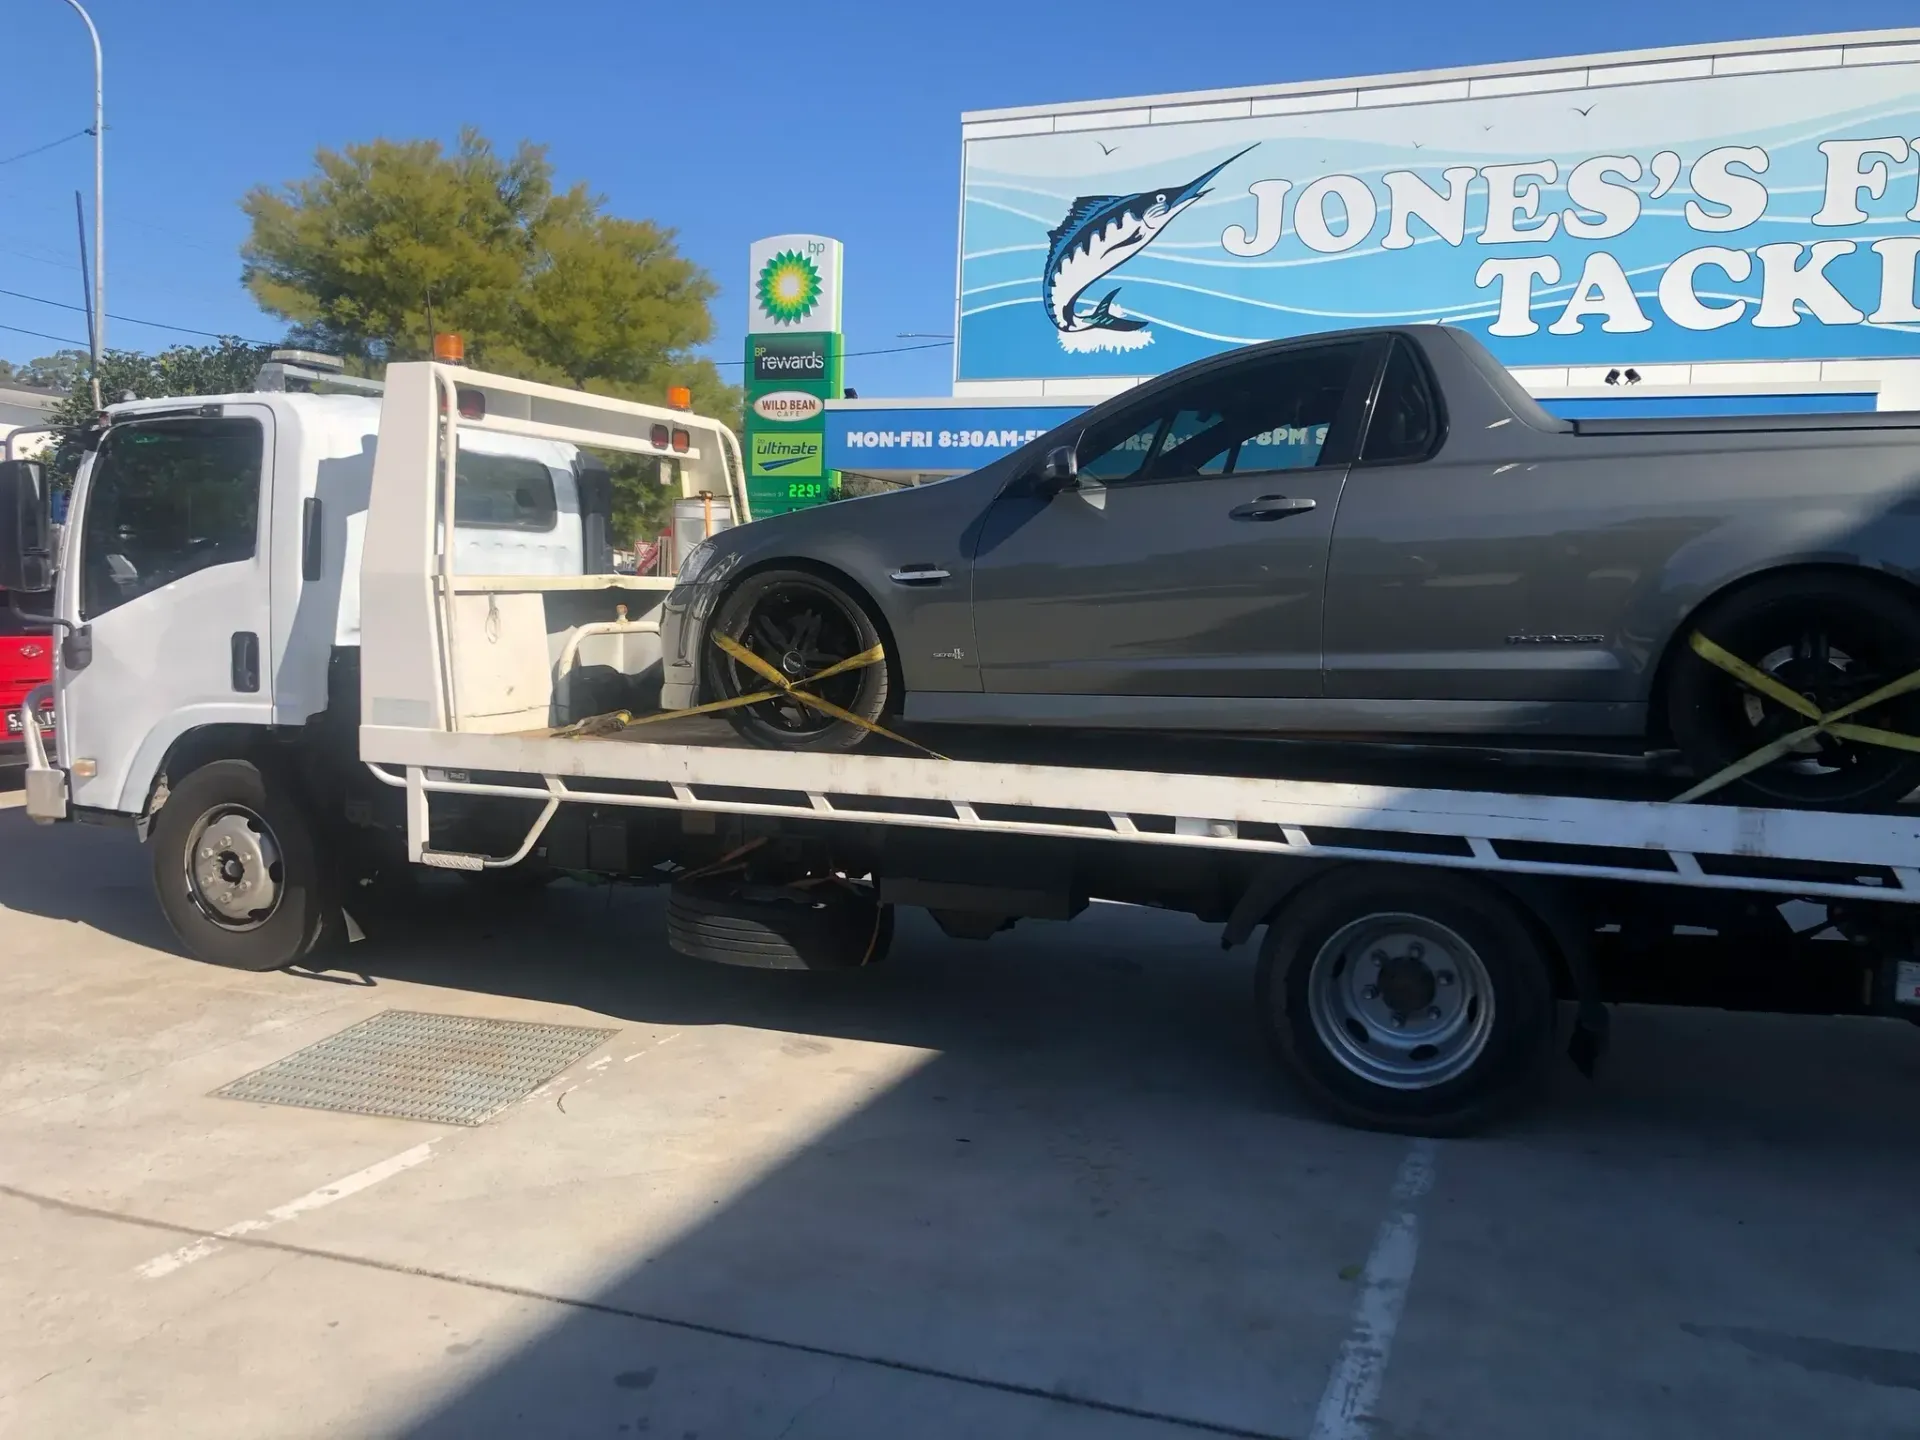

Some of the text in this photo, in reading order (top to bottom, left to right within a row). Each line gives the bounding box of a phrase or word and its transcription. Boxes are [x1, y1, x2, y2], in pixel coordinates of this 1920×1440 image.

[1811, 135, 1920, 227] F
[808, 240, 825, 256] bp
[755, 347, 767, 357] BP
[762, 351, 824, 370] rewards
[762, 399, 816, 411] WILD BEAN
[847, 430, 932, 448] MON-FRI
[757, 442, 818, 455] ultimate
